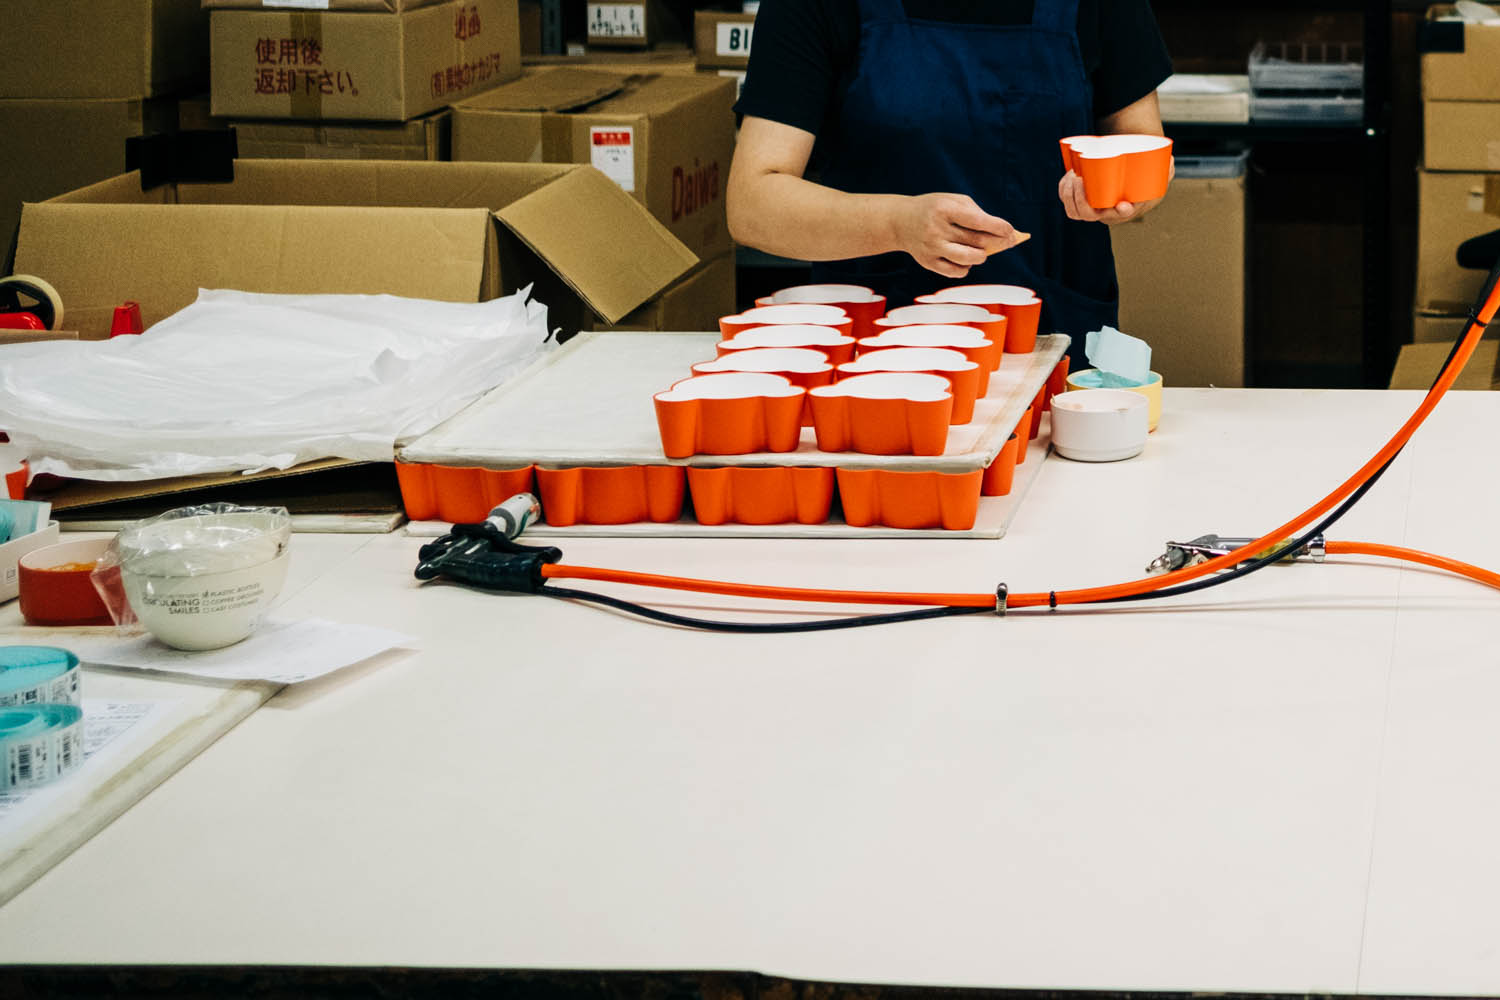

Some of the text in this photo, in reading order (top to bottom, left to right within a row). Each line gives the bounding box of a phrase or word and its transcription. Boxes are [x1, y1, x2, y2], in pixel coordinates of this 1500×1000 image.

[254, 38, 322, 66] 使用後
[254, 68, 360, 97] 返却下さい。
[168, 606, 201, 615] SMILES
